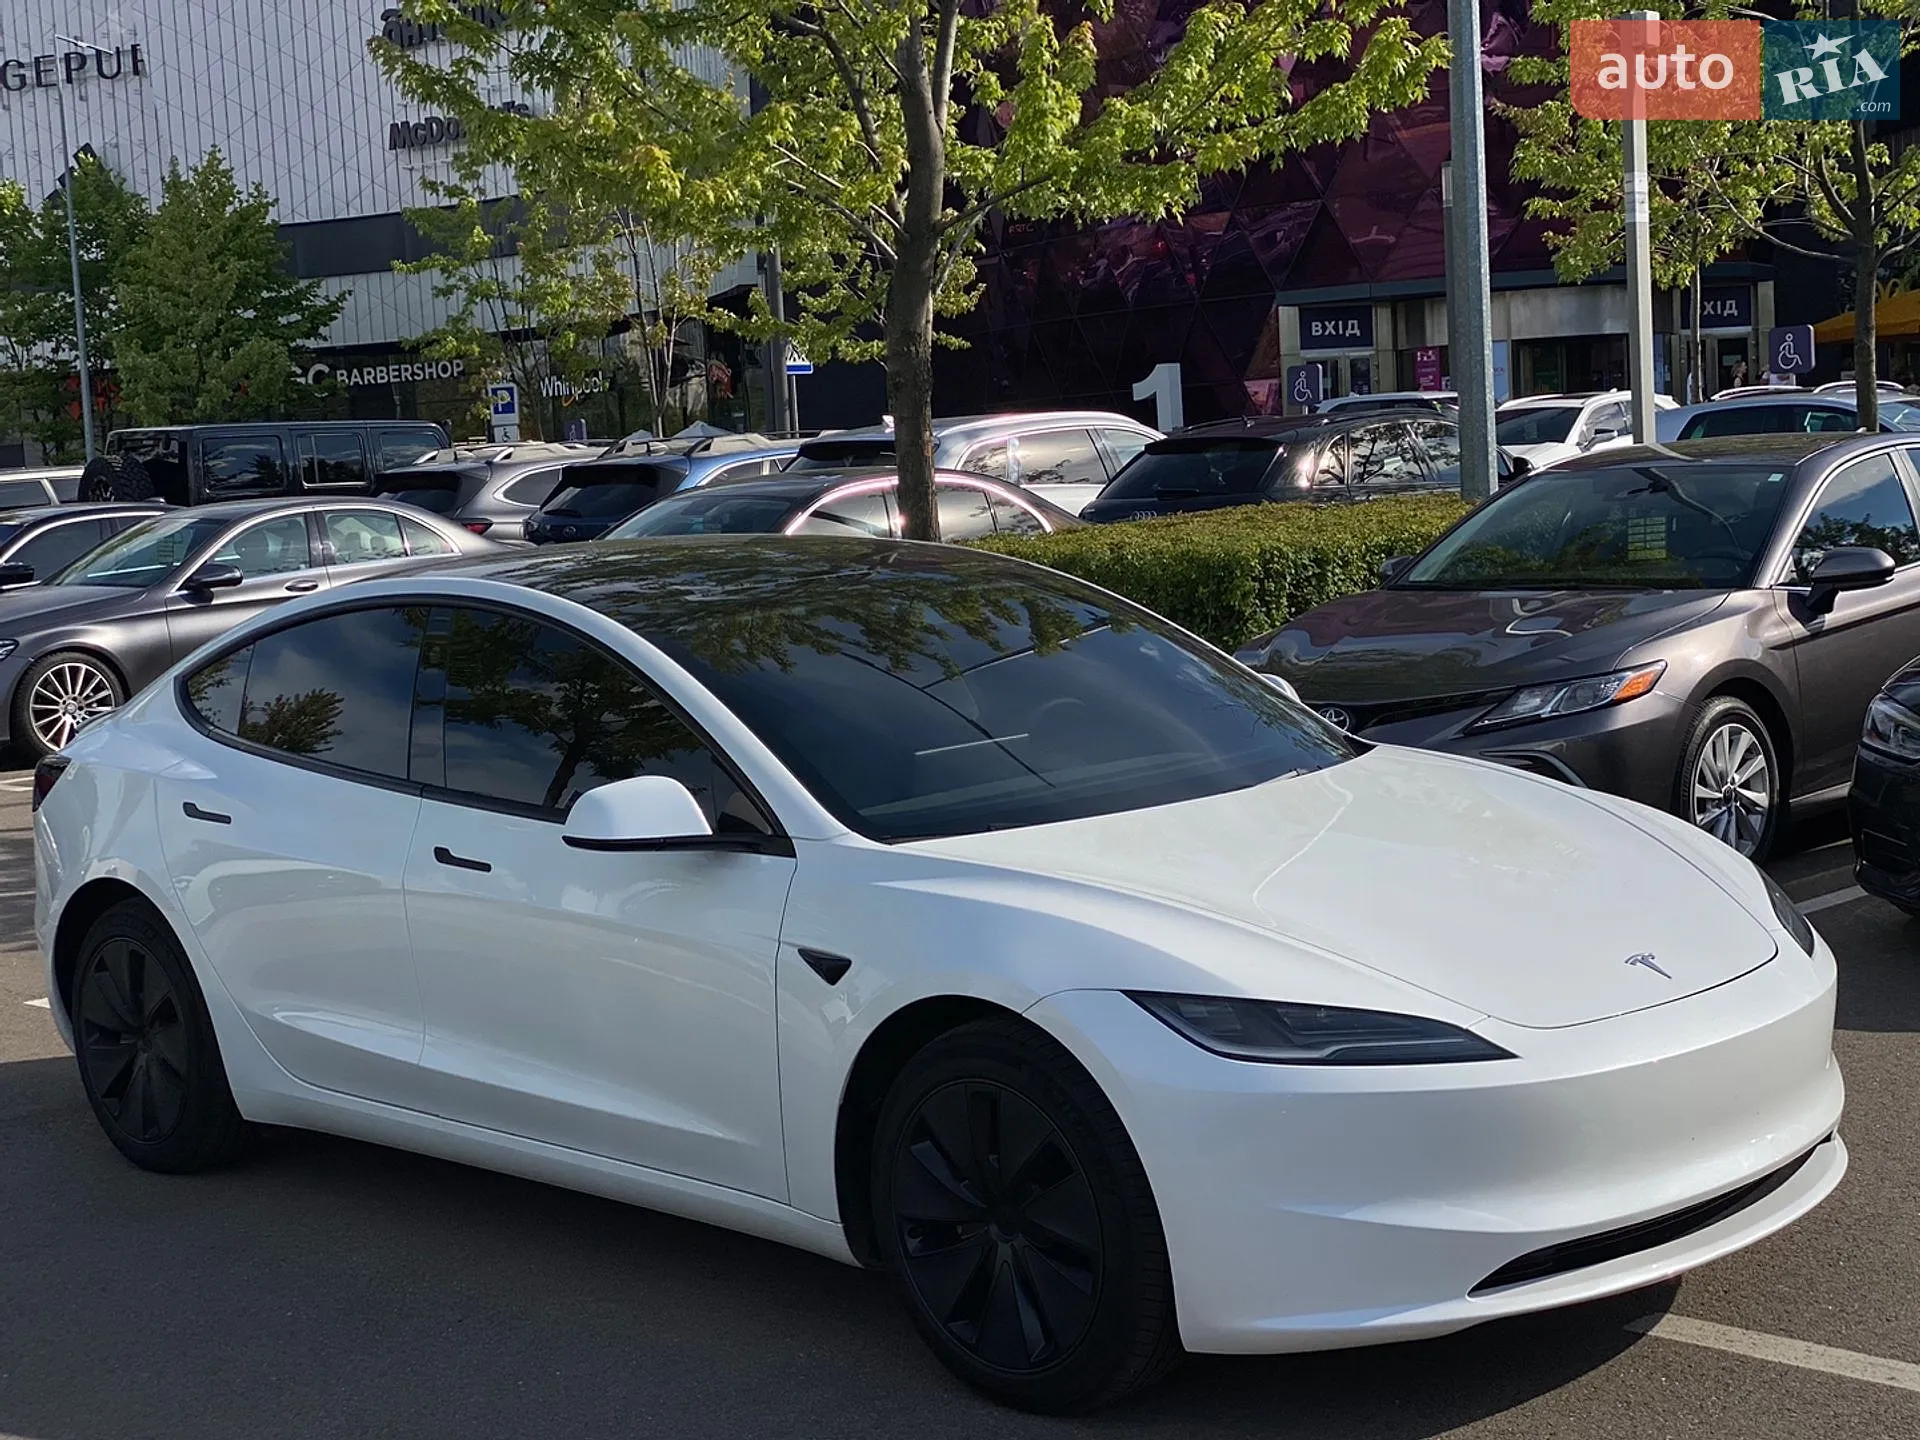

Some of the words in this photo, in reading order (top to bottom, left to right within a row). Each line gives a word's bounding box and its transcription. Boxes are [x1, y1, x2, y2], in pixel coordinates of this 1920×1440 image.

[1701, 299, 1738, 317] ХІД
[1311, 319, 1360, 337] ВХІД
[336, 359, 464, 387] BARBERSHOP
[1132, 362, 1183, 432] 1
